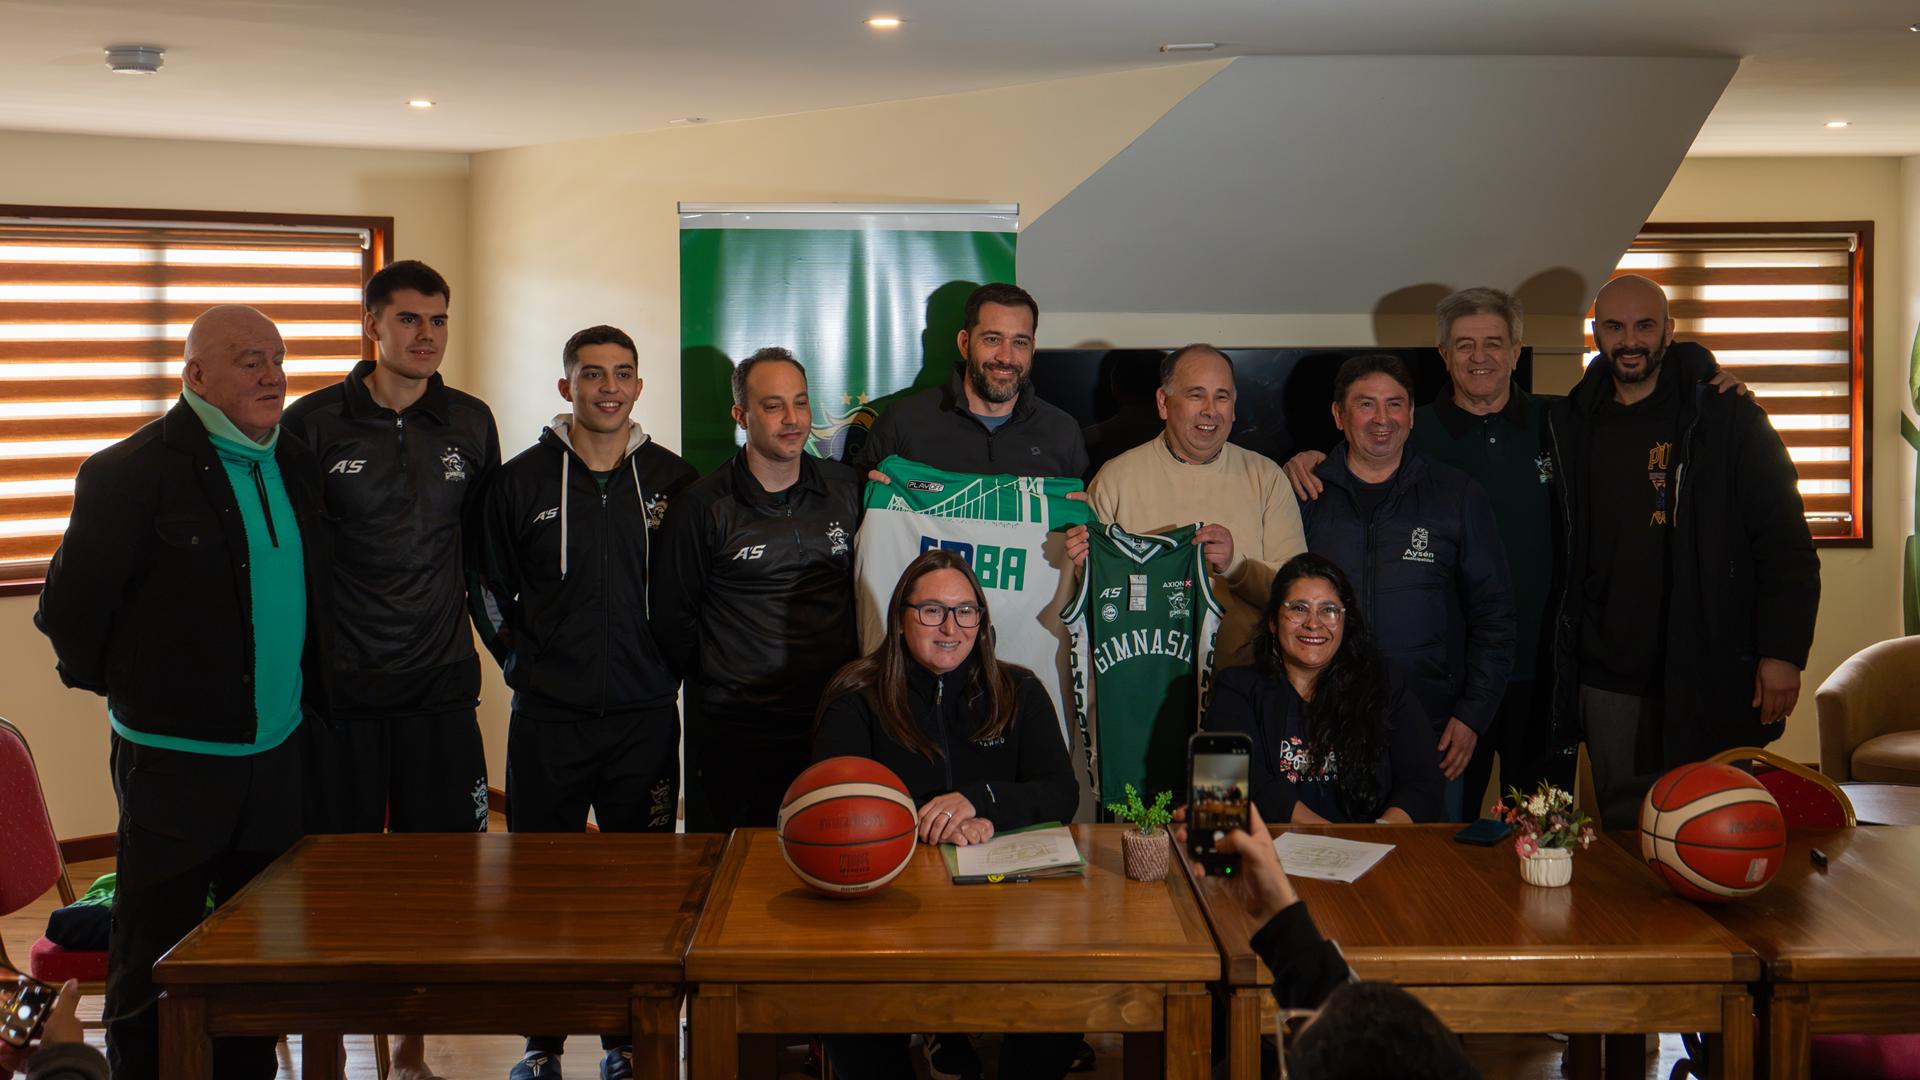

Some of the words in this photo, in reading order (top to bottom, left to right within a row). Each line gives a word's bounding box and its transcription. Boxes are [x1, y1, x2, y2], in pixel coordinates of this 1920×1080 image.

[328, 459, 367, 474] A'S
[732, 544, 767, 560] A'S
[1099, 587, 1122, 599] A'S
